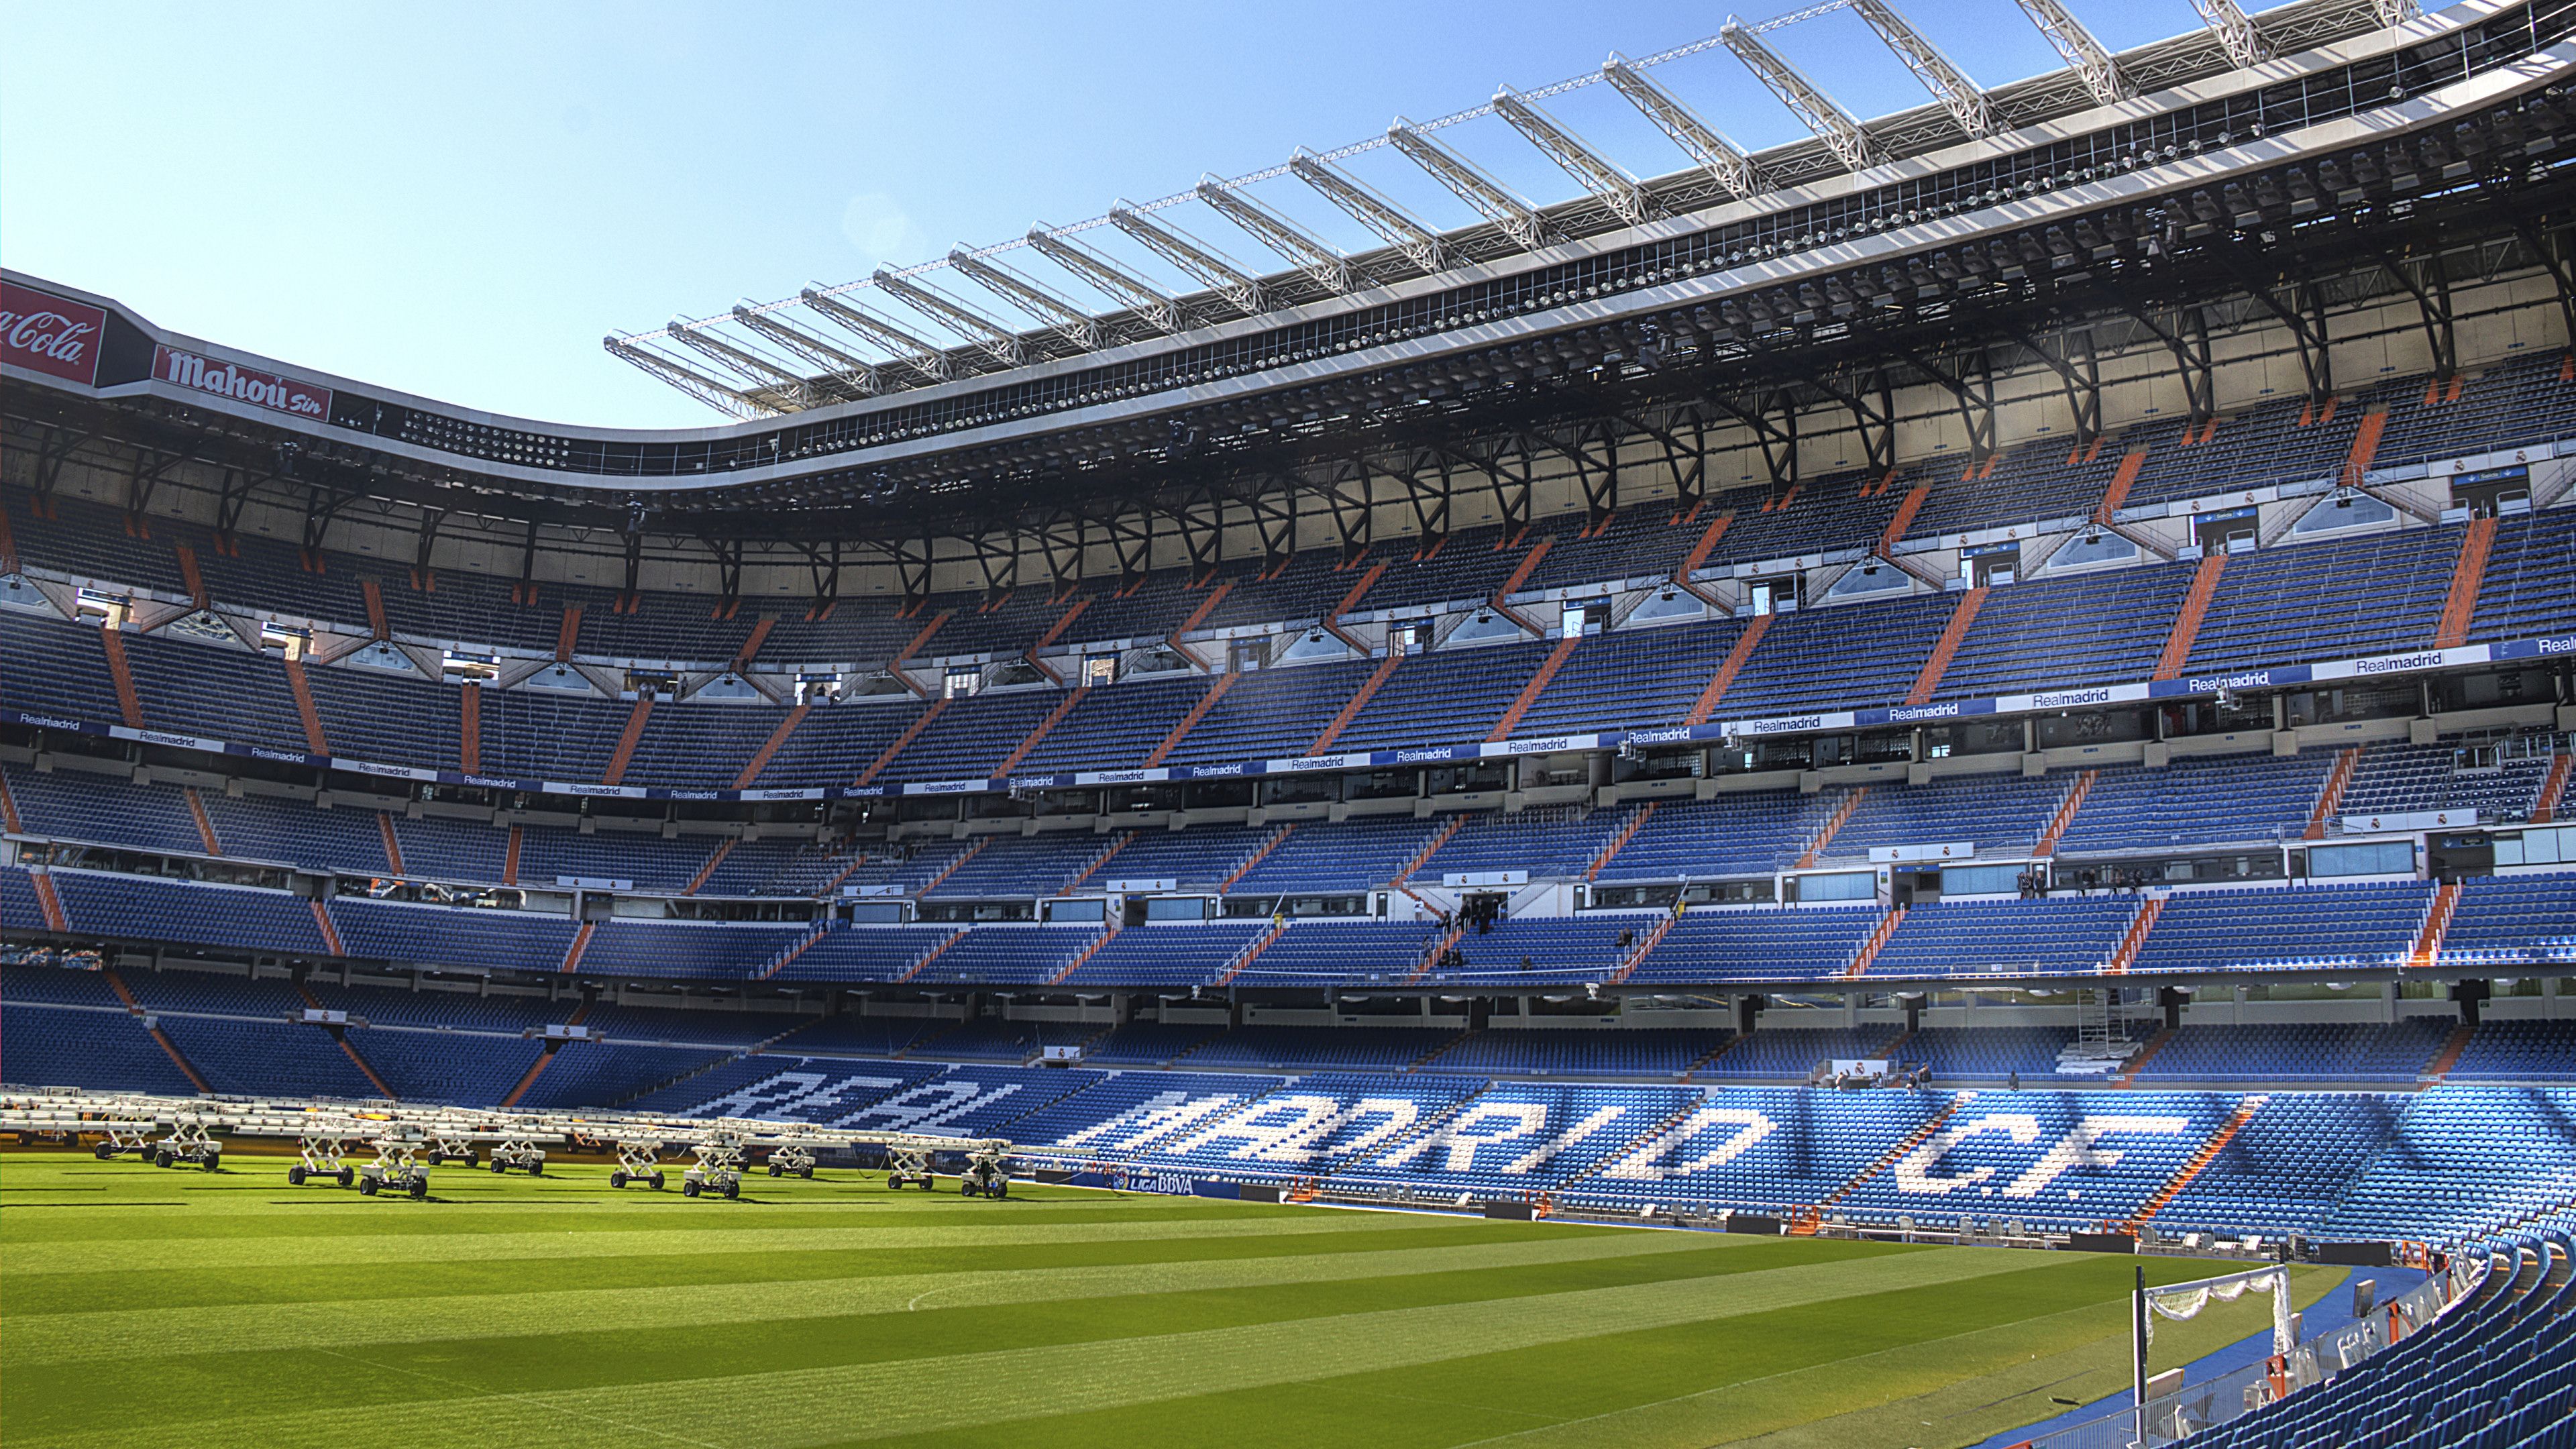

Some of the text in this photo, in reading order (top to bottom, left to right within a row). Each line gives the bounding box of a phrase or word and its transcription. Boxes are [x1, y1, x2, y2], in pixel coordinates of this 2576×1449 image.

[169, 352, 286, 409] Mahou
[2357, 651, 2443, 674] Realmadrid
[2190, 671, 2270, 691] Realmadrid
[2034, 689, 2108, 708] Realmadrid
[1890, 704, 1957, 720] Realmadrid
[20, 713, 79, 731] Realmadrid
[1754, 716, 1820, 733] Realmadrid
[141, 731, 195, 747] Realmadrid
[1629, 727, 1690, 744] Realmadrid
[1509, 739, 1566, 753] Realmadrid
[252, 747, 305, 763] Realmadrid
[1397, 747, 1451, 762] Realmadrid
[359, 763, 410, 776] Realmadrid
[1193, 763, 1241, 777] Realmadrid
[1292, 756, 1343, 769] Realmadrid
[464, 775, 515, 788] Realmadrid
[1010, 776, 1053, 787] Realmadrid
[1099, 770, 1144, 782] Realmadrid
[571, 785, 620, 796] Realmadrid
[764, 790, 803, 798] Realmadrid
[844, 786, 883, 796] Realmadrid
[925, 782, 965, 792] Realmadrid
[672, 790, 717, 800] Realmadrid
[1055, 1089, 1778, 1182] MADRID
[1130, 1175, 1193, 1194] LIGA BBVA
